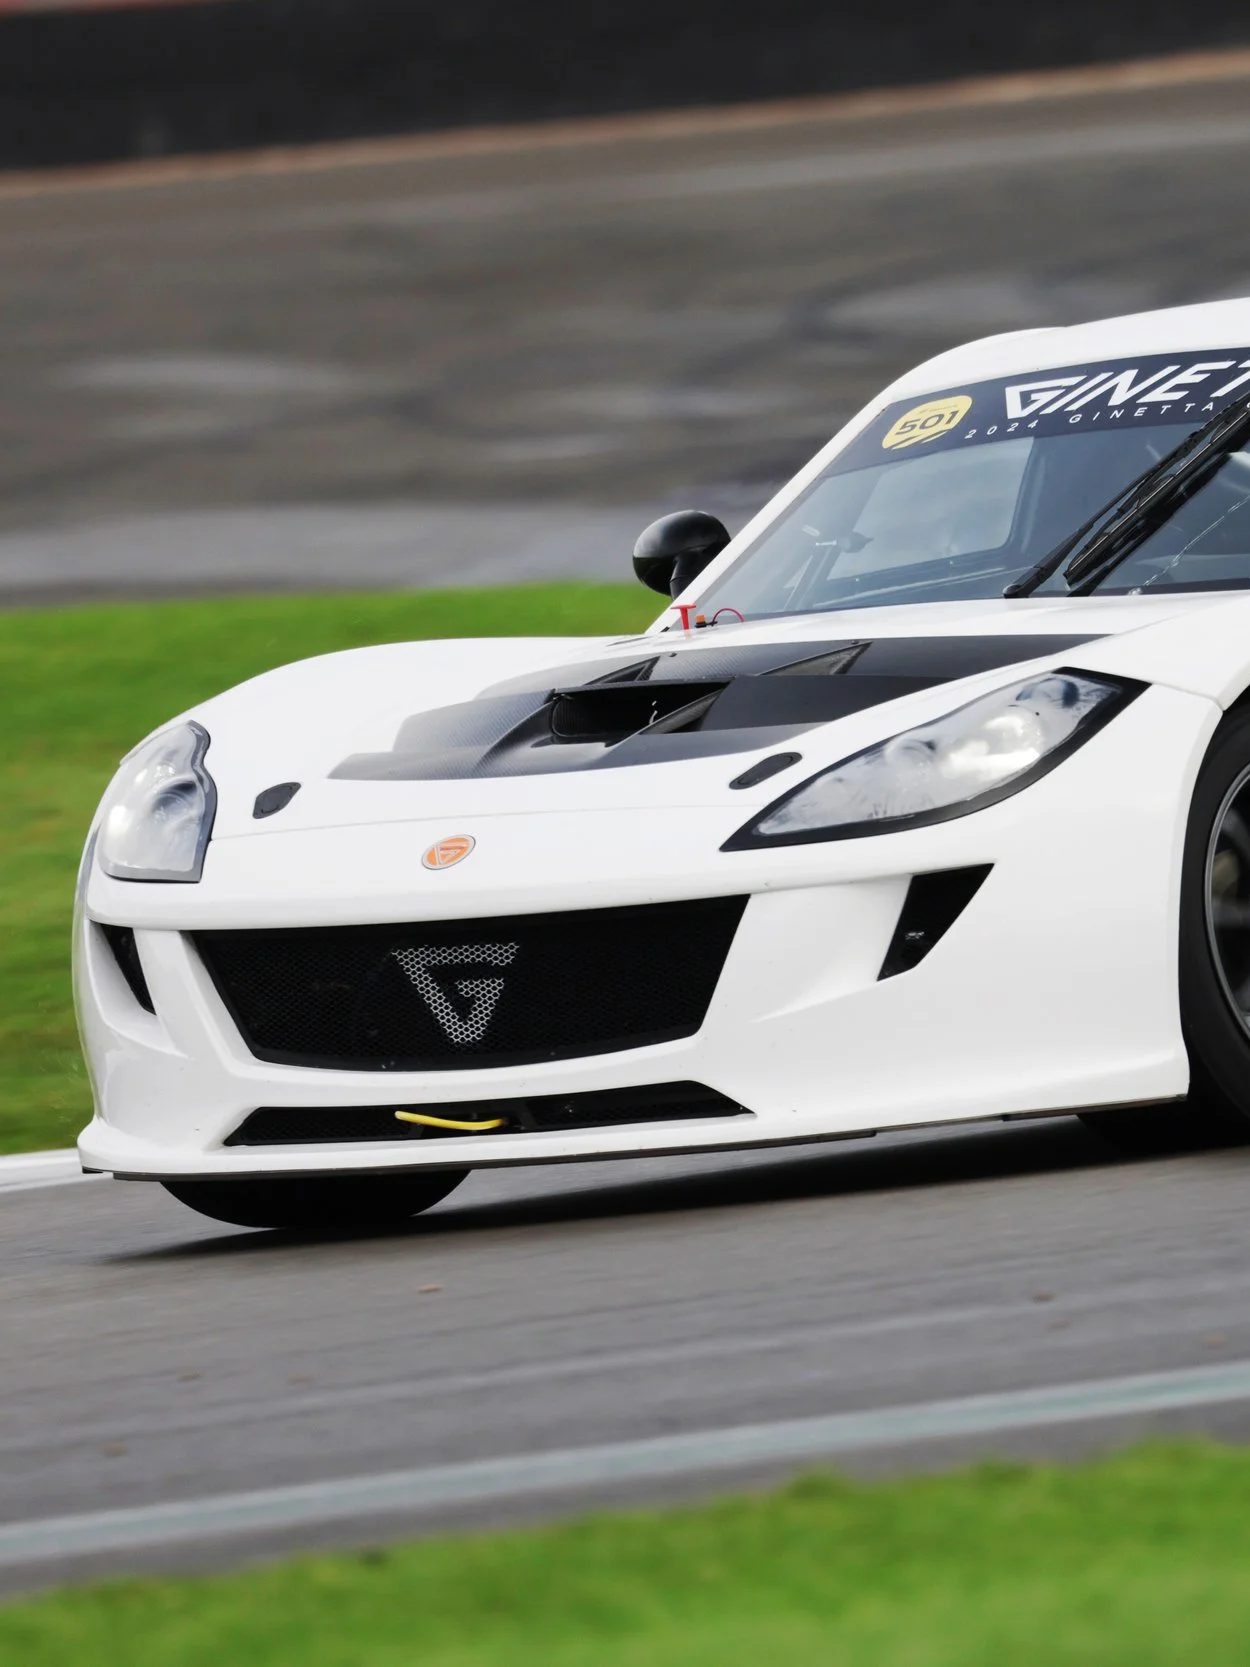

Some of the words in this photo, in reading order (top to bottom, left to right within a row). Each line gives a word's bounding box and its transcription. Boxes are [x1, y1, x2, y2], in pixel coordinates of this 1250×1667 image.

[895, 410, 960, 436] 501
[964, 419, 1039, 440] 2024
[1068, 401, 1214, 424] GINETTA
